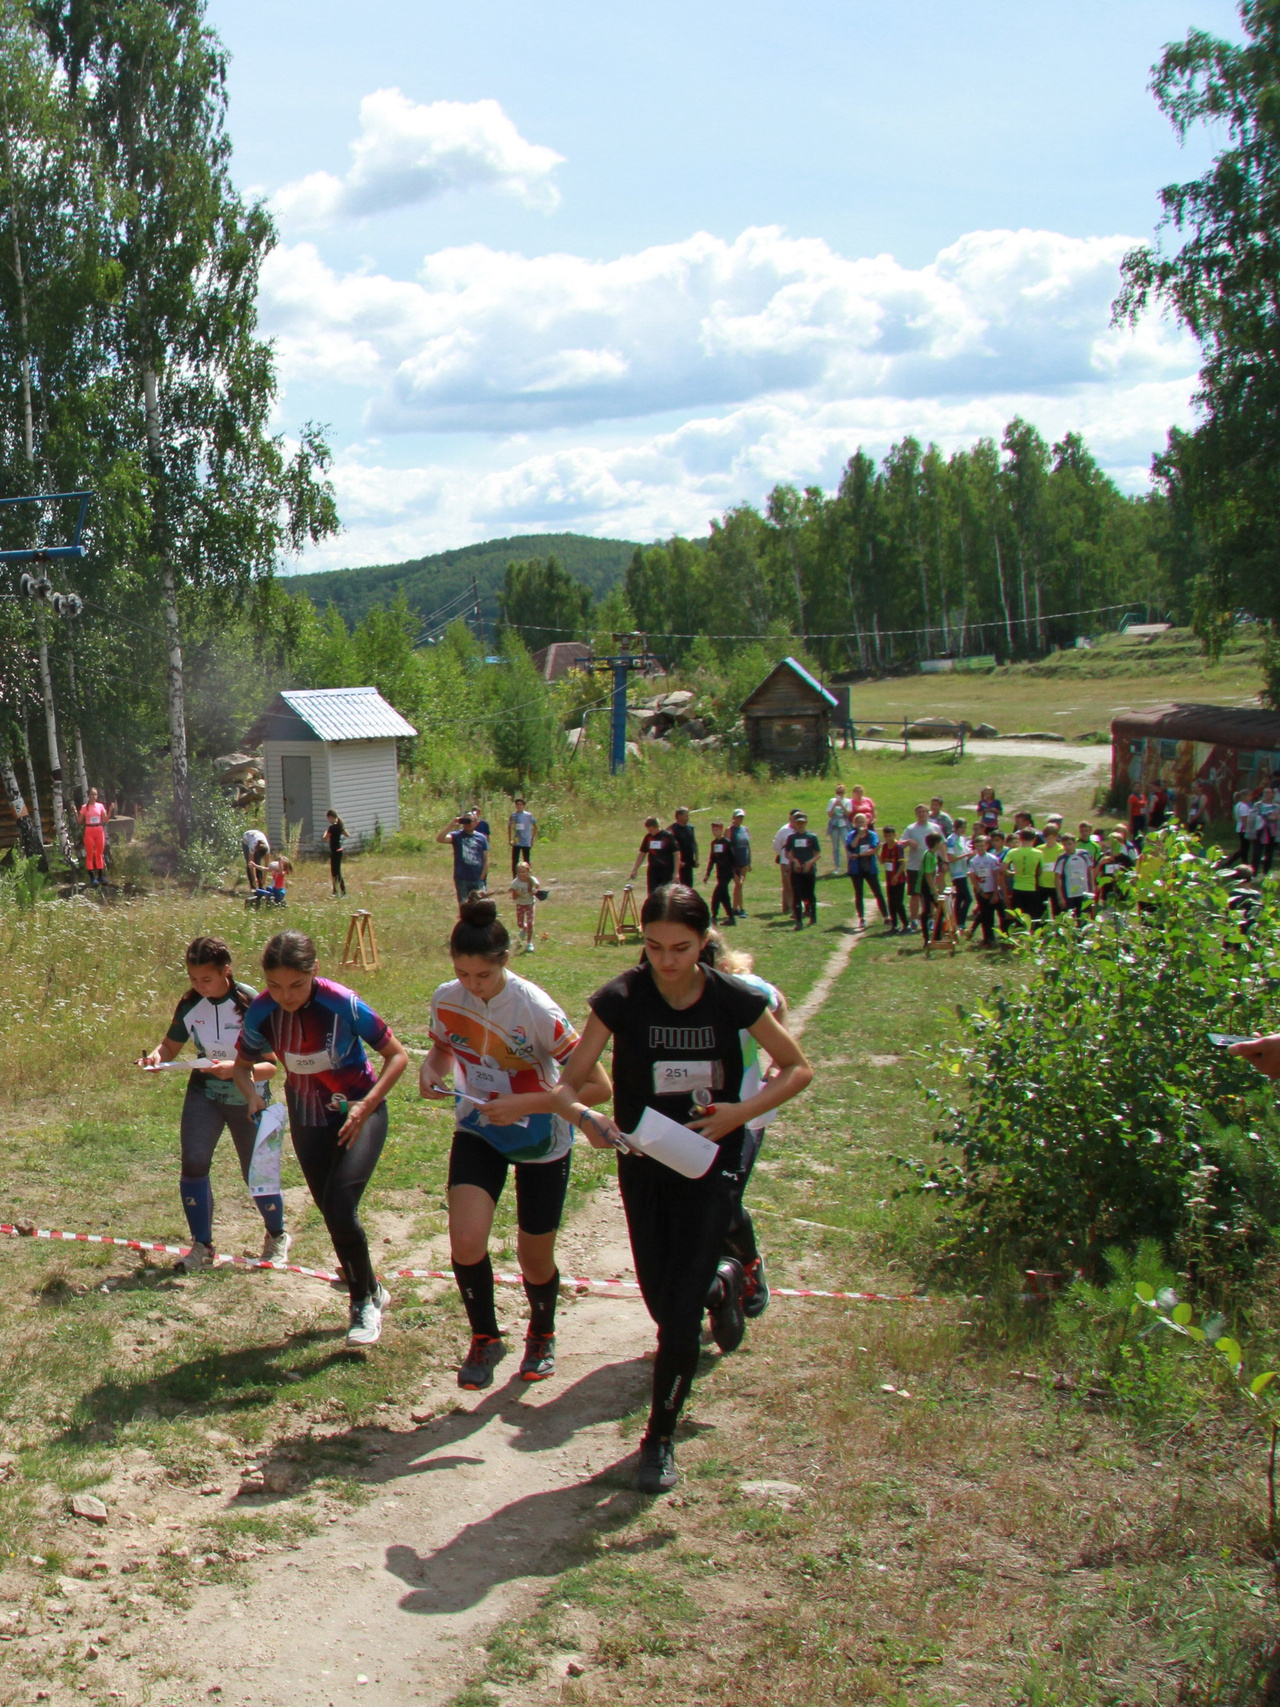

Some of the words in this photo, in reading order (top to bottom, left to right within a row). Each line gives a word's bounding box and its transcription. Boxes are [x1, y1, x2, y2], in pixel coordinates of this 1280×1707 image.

[649, 1026, 715, 1050] PUMA
[212, 1050, 227, 1058] 256
[476, 1070, 494, 1082] 253
[665, 1068, 689, 1078] 251
